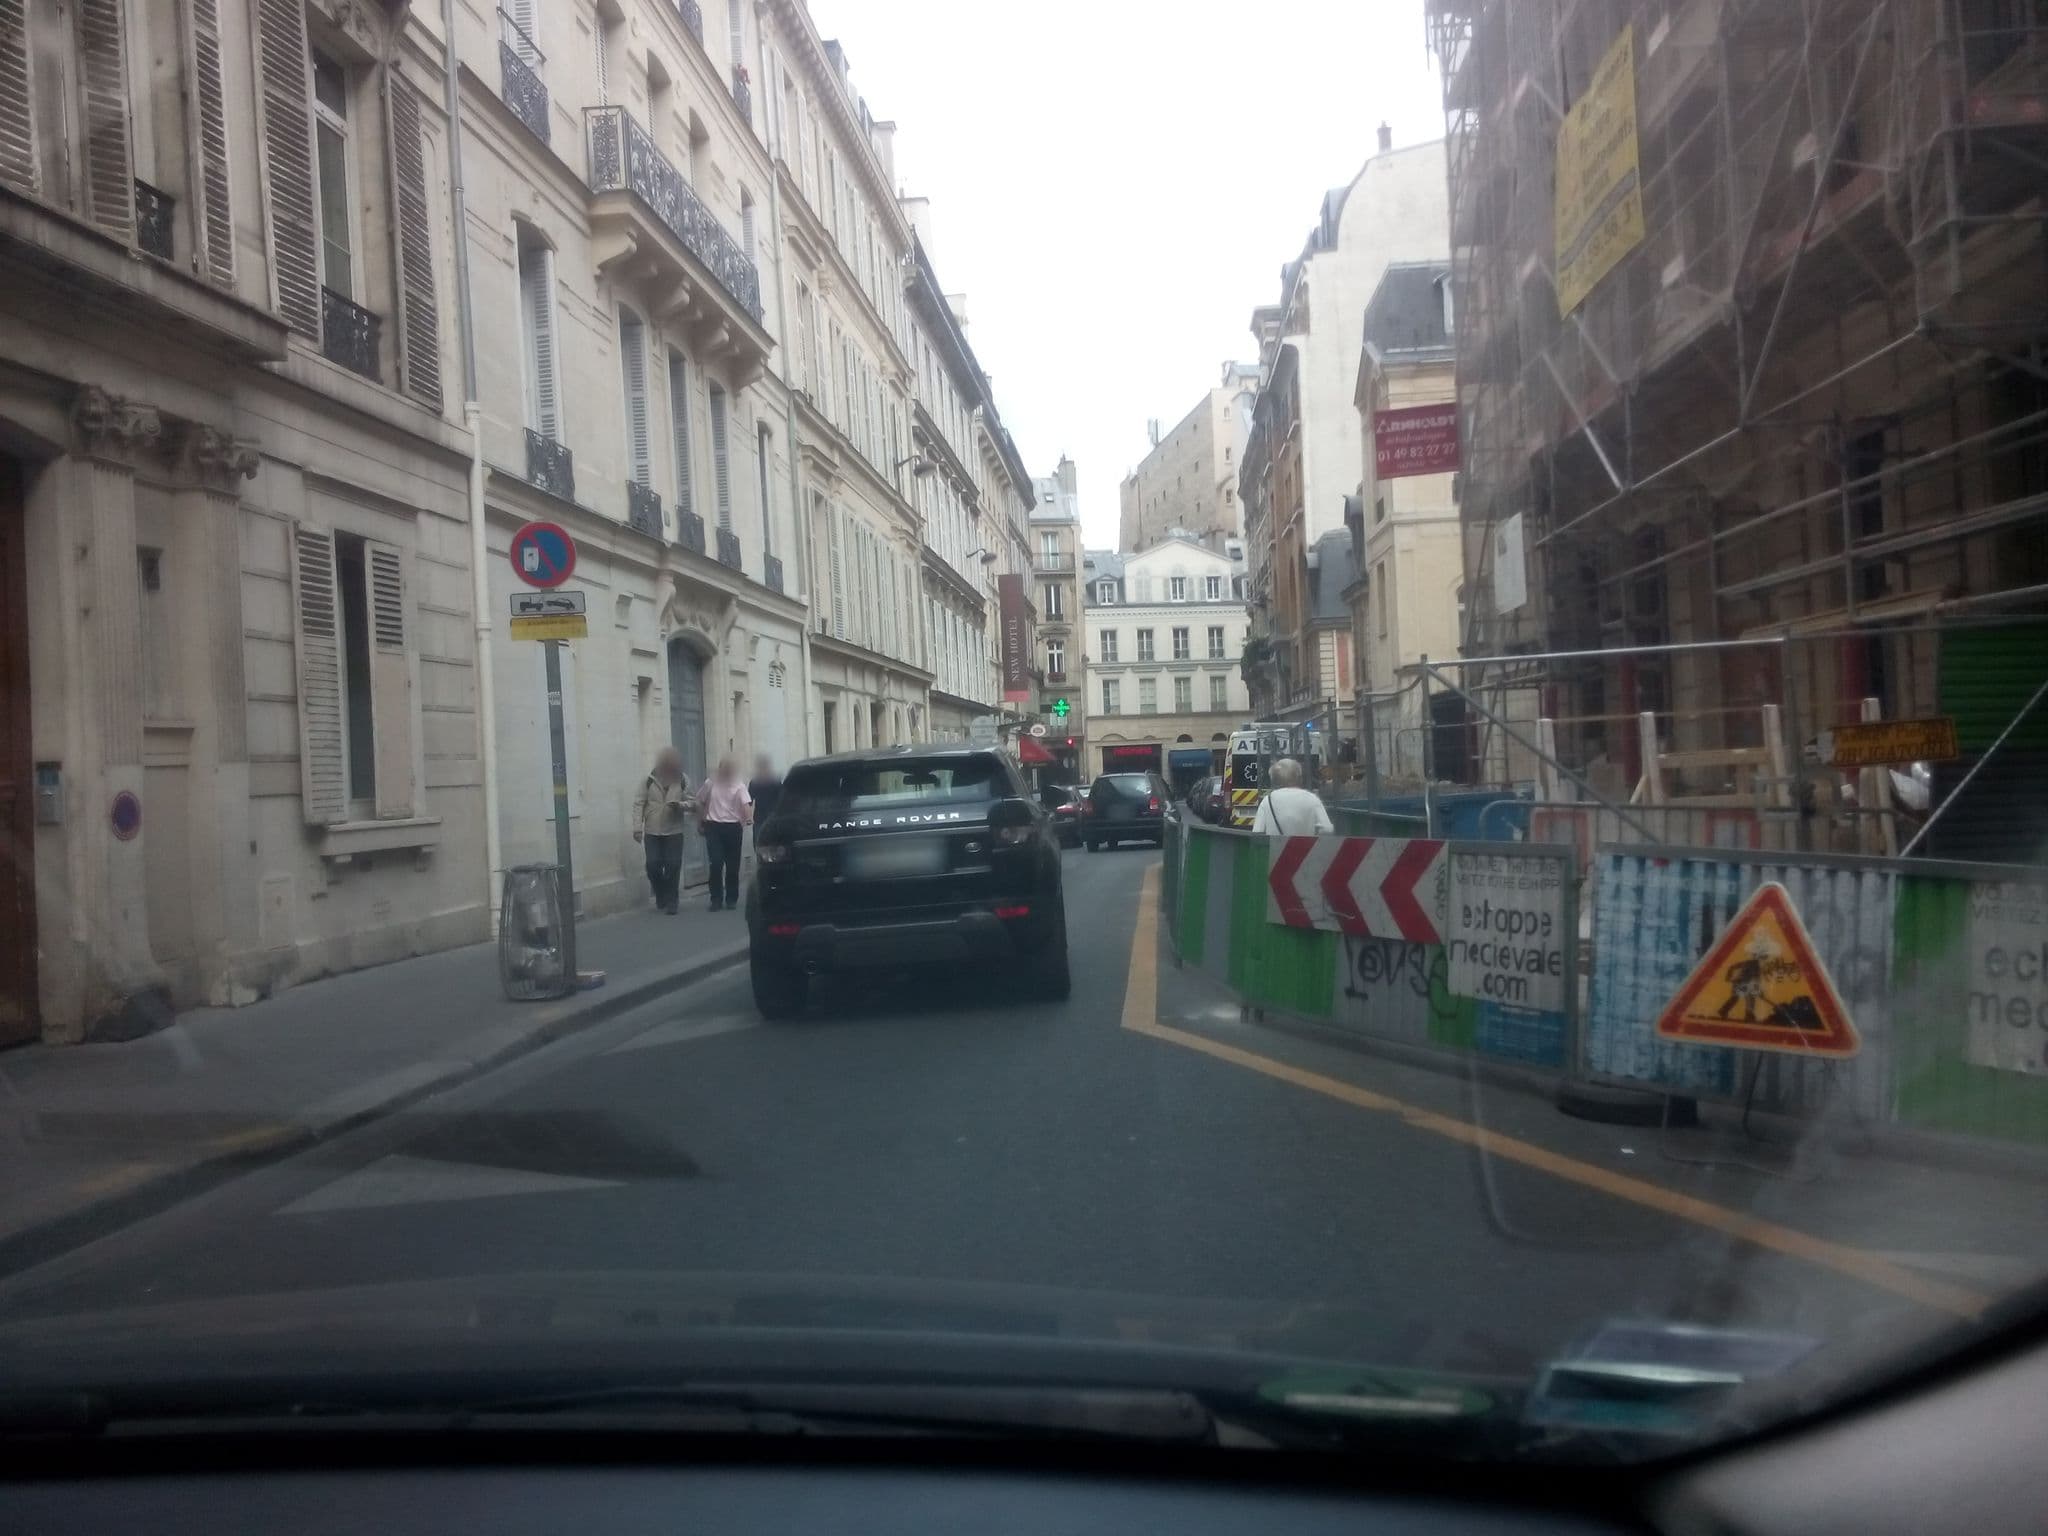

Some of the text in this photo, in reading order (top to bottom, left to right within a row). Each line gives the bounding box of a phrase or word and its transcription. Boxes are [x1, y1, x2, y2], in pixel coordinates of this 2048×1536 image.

[1378, 449, 1390, 462] 01
[1394, 447, 1407, 459] 49
[1410, 446, 1424, 457] 82
[1426, 444, 1440, 456] 27
[1008, 617, 1020, 682] NEW HOTEL
[819, 812, 961, 830] RANGE ROVER
[1474, 972, 1528, 1002] .com
